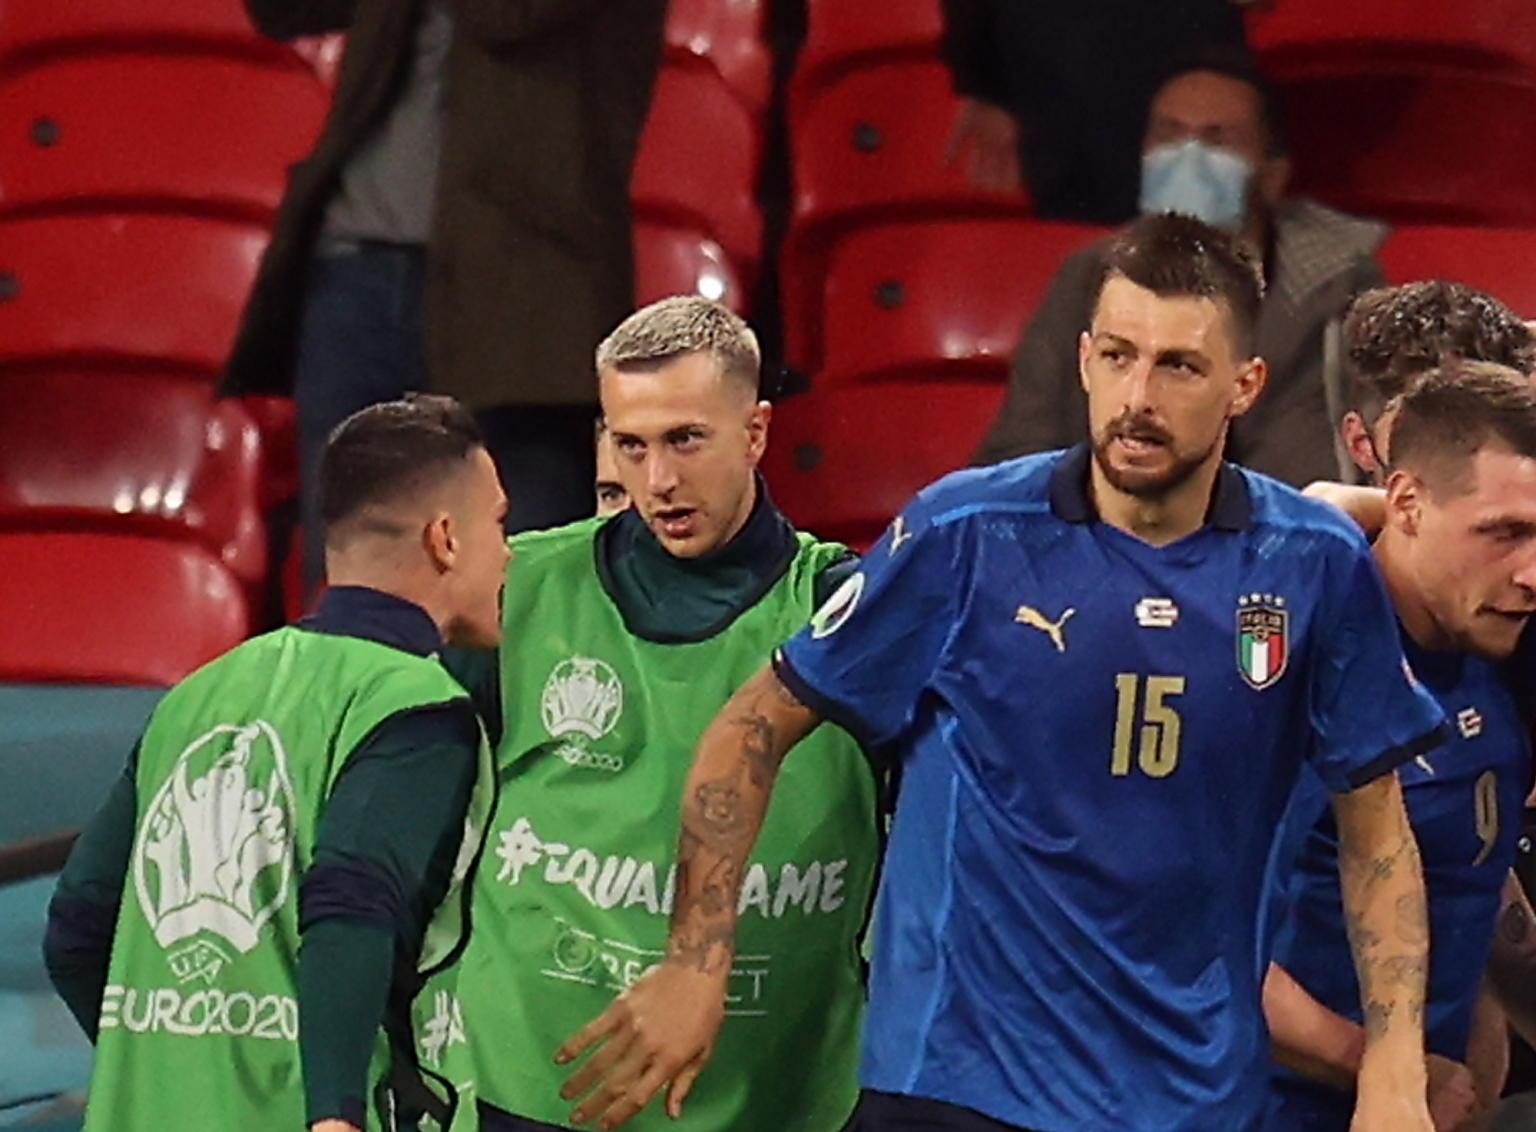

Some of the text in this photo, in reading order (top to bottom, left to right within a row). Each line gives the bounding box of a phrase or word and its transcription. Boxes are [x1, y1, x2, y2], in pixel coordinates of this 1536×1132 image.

[1110, 672, 1187, 779] 15
[1471, 770, 1499, 867] 9
[98, 983, 299, 1041] EURO2020
